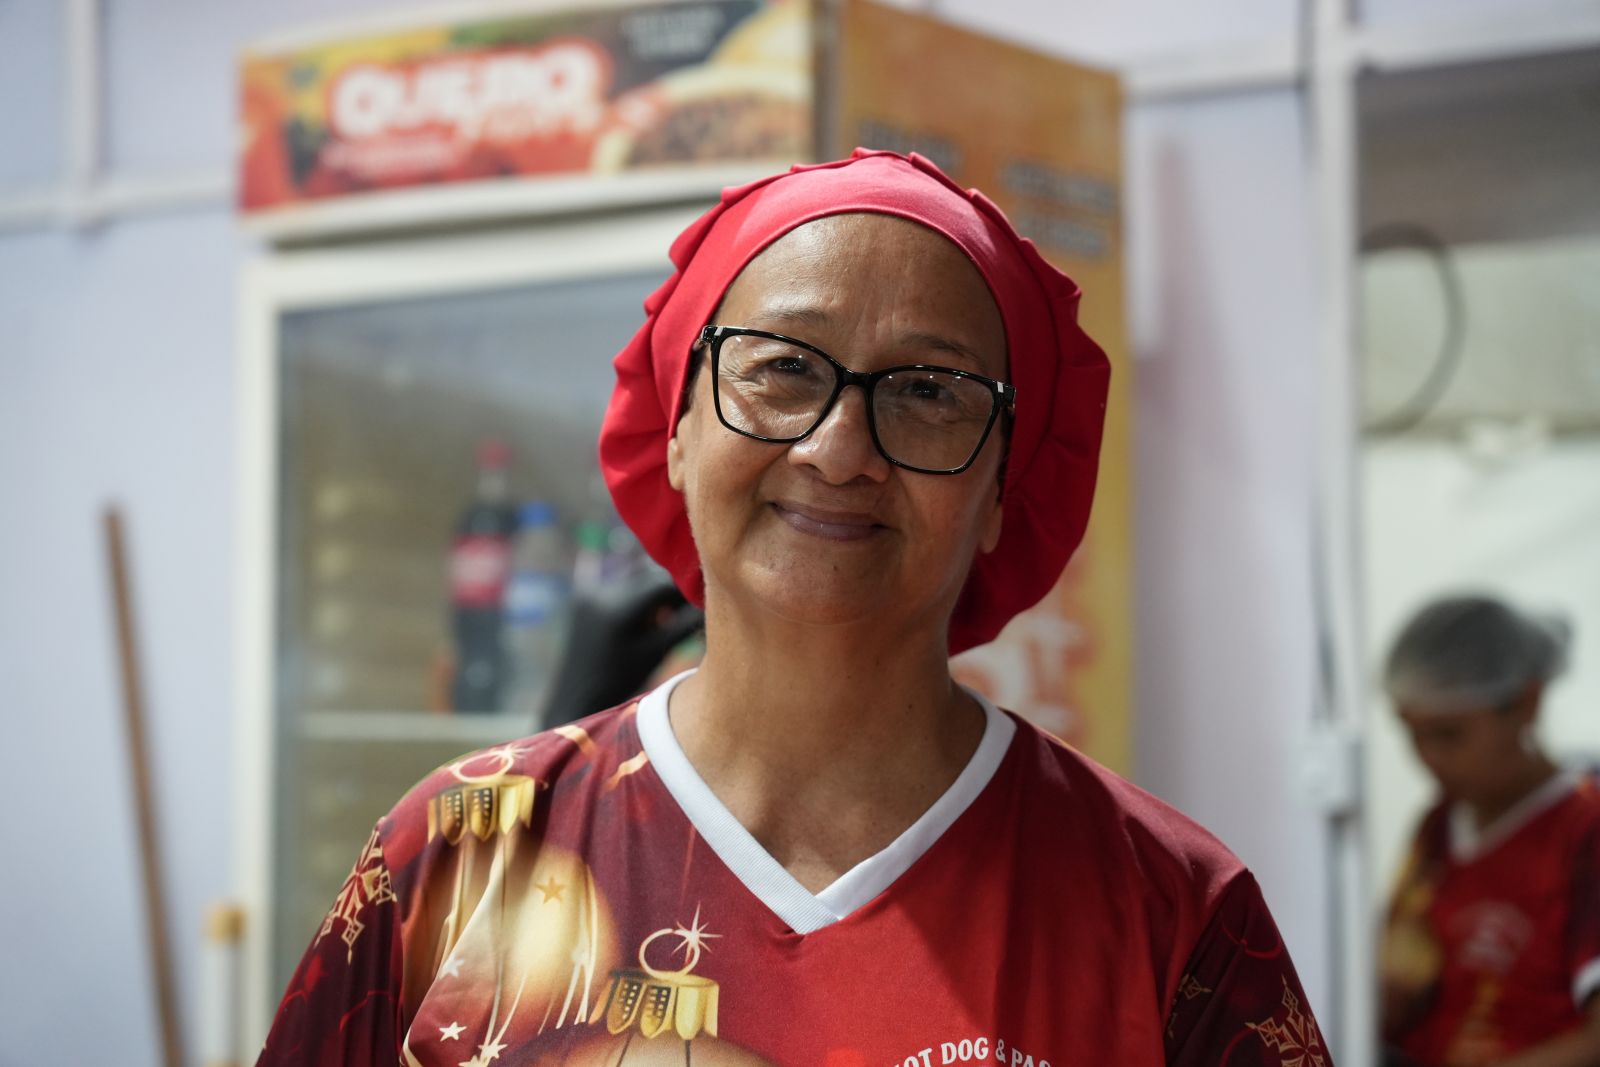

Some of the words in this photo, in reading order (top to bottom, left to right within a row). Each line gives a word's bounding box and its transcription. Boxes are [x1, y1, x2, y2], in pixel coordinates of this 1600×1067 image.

[894, 1047, 933, 1067] OT
[941, 1037, 989, 1064] DOG
[995, 1039, 1007, 1063] &
